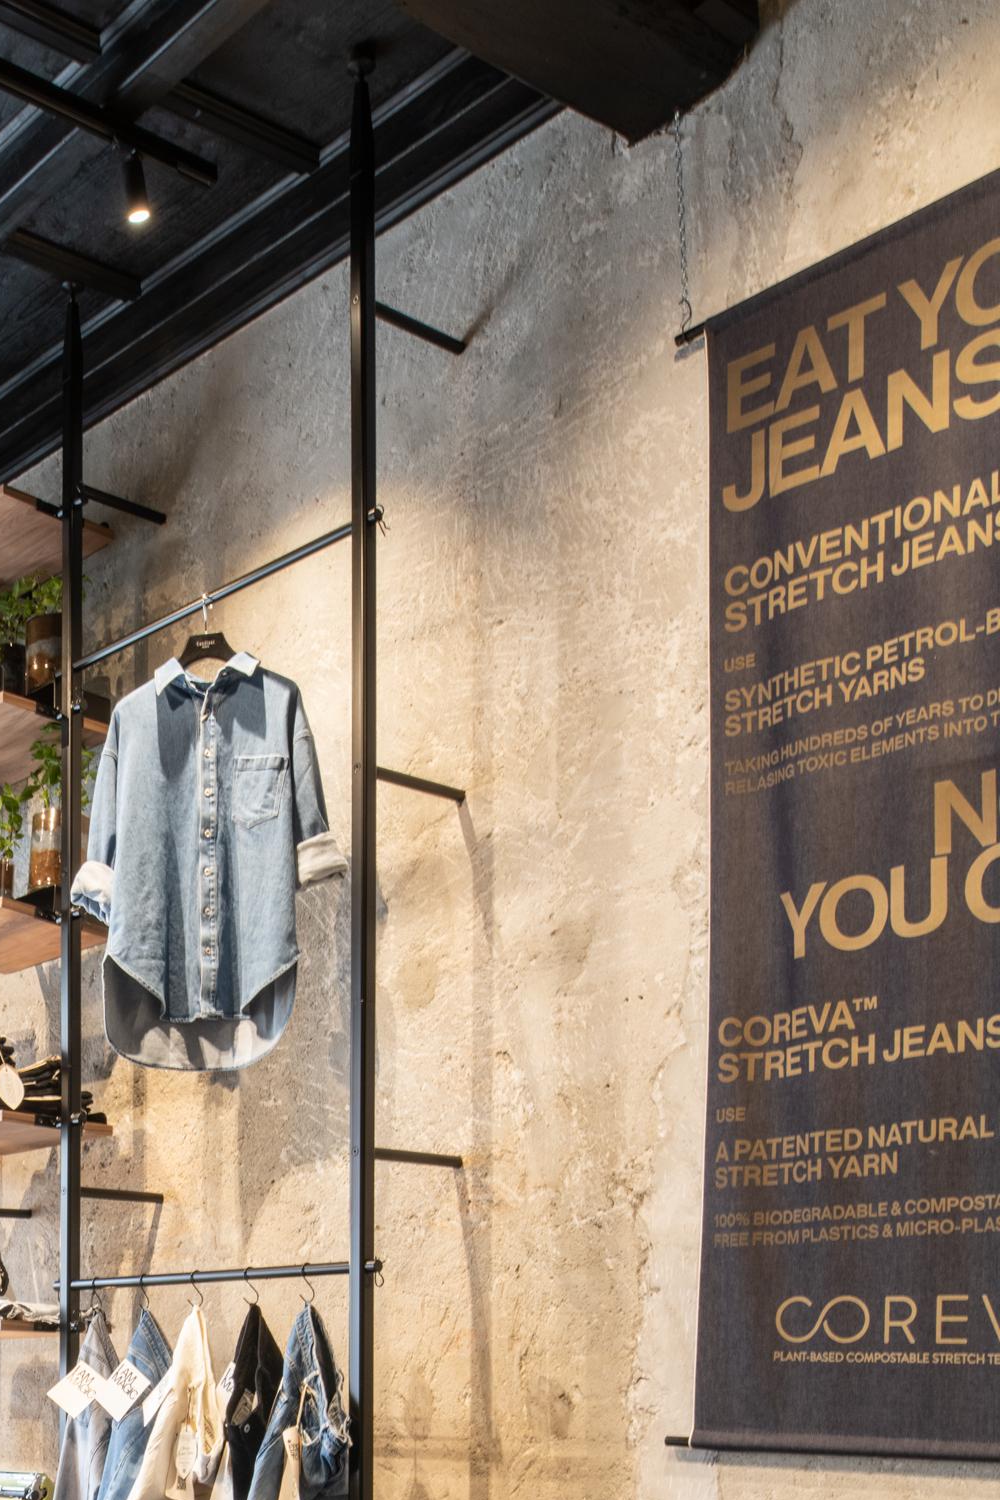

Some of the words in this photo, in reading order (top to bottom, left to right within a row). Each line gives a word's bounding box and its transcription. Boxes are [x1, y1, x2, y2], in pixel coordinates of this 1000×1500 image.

[726, 291, 887, 434] EAT
[722, 327, 1000, 512] JEANS
[724, 470, 1000, 597] CONVENTIONAL
[724, 551, 884, 633] STRETCH
[891, 510, 1000, 577] JEAN
[724, 653, 755, 673] USE
[725, 652, 861, 712] SYNTHETIC
[725, 684, 832, 737] STRETCH
[838, 657, 925, 703] YARNS
[725, 746, 779, 777] TAKING
[781, 724, 868, 762] HUNDREDS
[871, 716, 893, 736] OF
[895, 700, 954, 730] YEARS
[959, 694, 984, 713] TO
[987, 688, 1000, 707] D
[725, 765, 795, 796] RELASING
[797, 751, 847, 775] TOXIC
[850, 725, 939, 762] ELEMENTS
[944, 715, 988, 739] INTO
[780, 856, 948, 960] YOU
[717, 1034, 876, 1083] STRETCH
[883, 1015, 1000, 1062] JEANS
[715, 1141, 729, 1162] A
[734, 1128, 863, 1161] PATENTED
[868, 1115, 994, 1149] NATURAL
[716, 1107, 745, 1123] USE
[715, 1158, 822, 1189] STRETCH
[827, 1150, 898, 1178] YARN
[713, 1232, 748, 1248] FREE
[752, 1229, 800, 1246] FROM
[802, 1224, 878, 1243] PLASTICS
[882, 1223, 892, 1238] &
[714, 1212, 750, 1228] 100%
[754, 1202, 888, 1225] BIODEGRADABLE
[891, 1202, 901, 1217] &
[773, 1350, 845, 1364] PLANT-BASED
[846, 1350, 930, 1365] COMPOSTABLE
[932, 1352, 985, 1365] STRETCH
